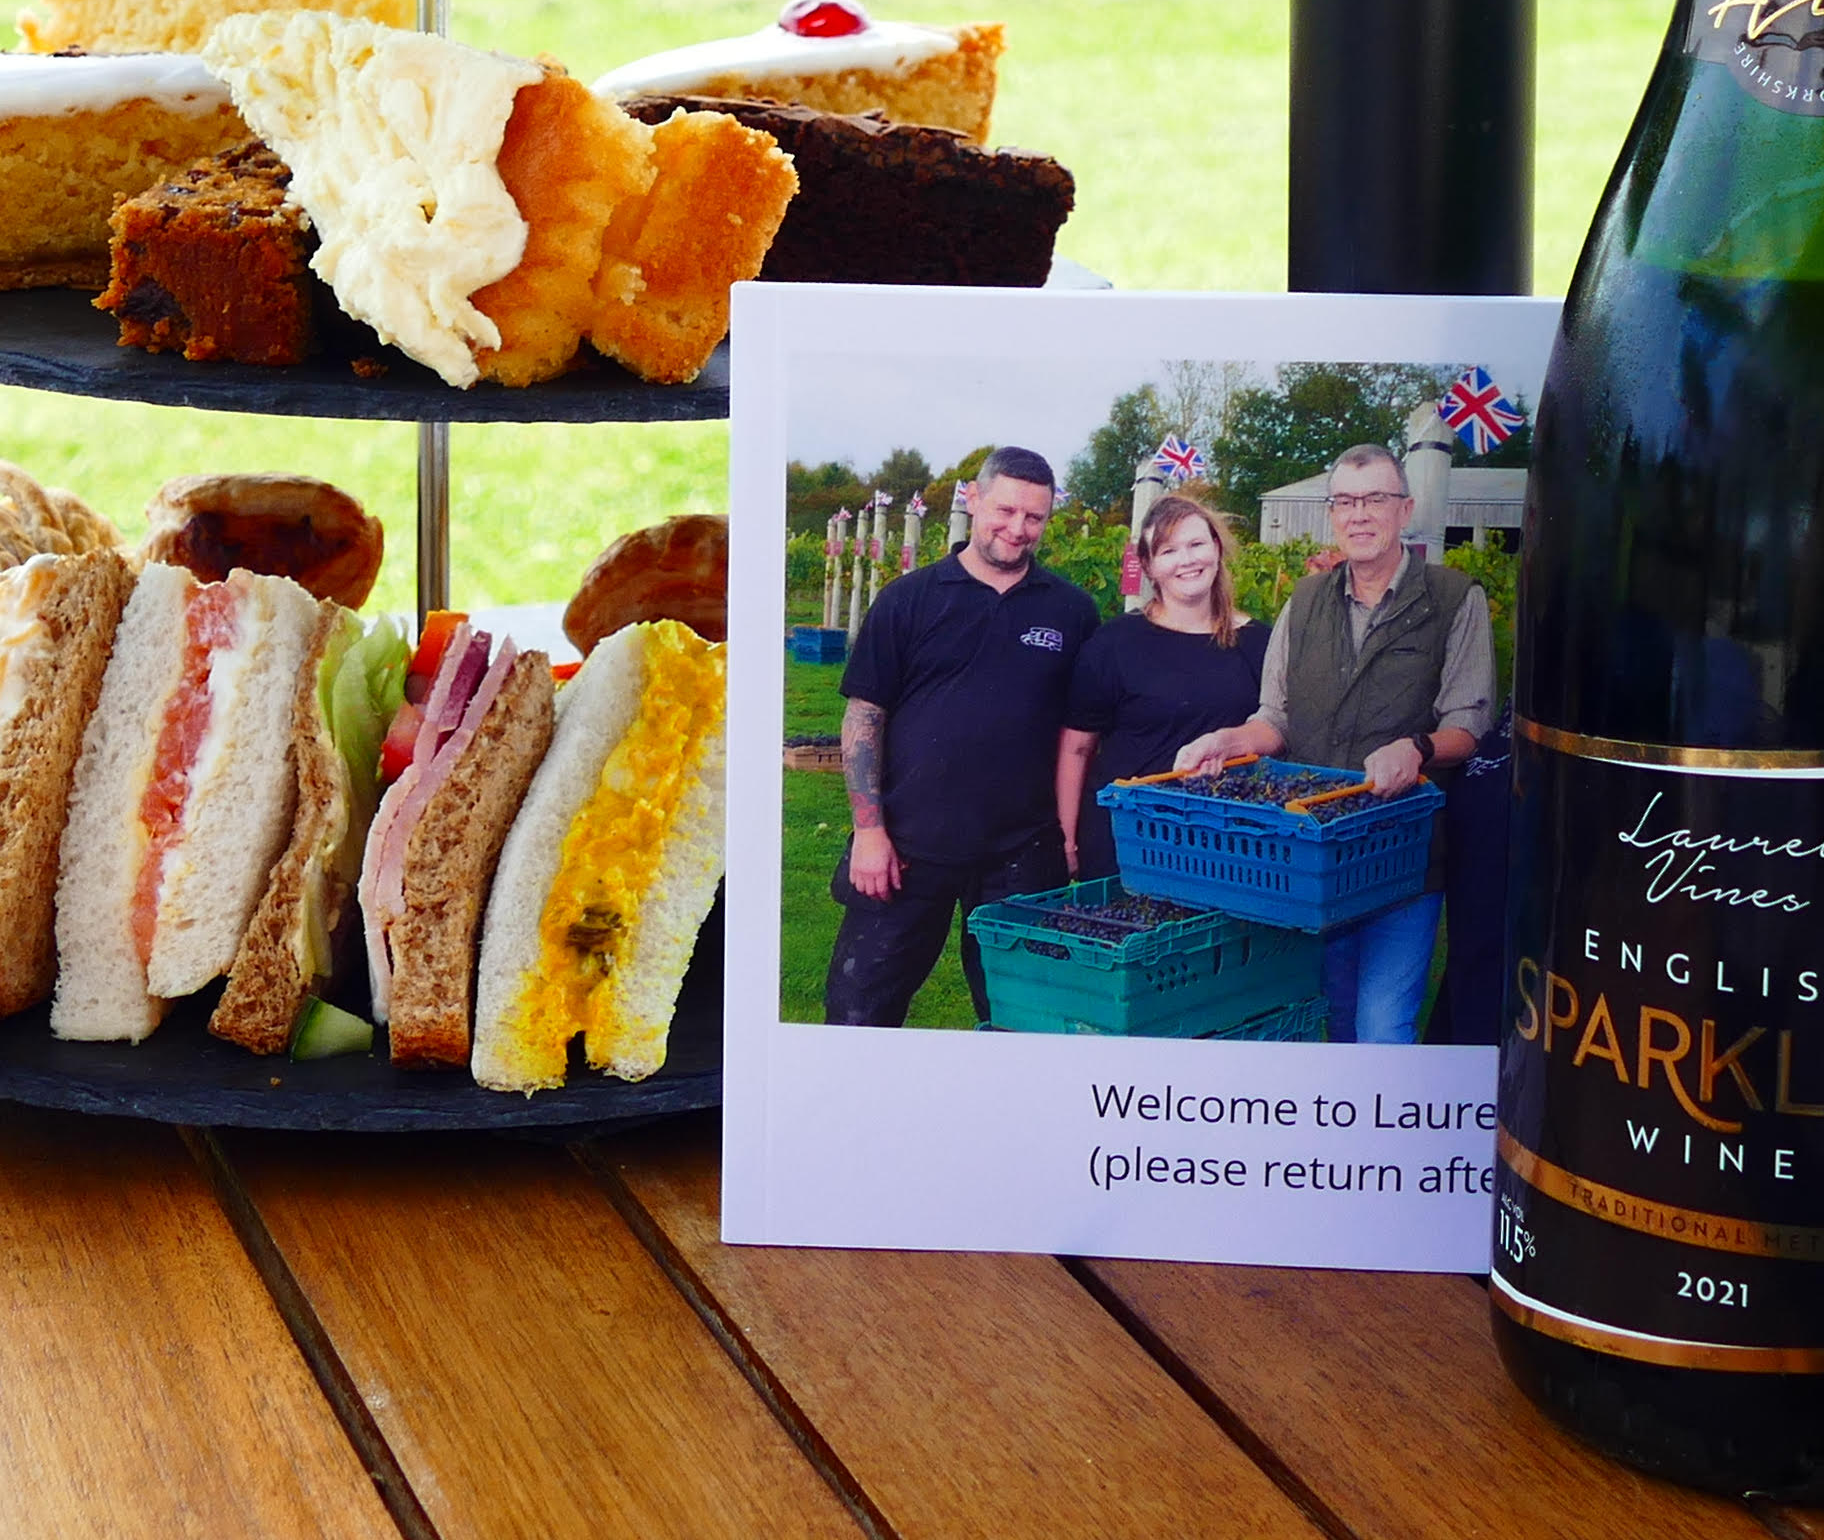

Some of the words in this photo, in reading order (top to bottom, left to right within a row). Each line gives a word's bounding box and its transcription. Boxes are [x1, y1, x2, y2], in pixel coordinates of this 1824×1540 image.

[1644, 848, 1811, 913] Vines
[1091, 1083, 1298, 1126] Welcome
[1313, 1094, 1358, 1128] to
[1374, 1093, 1496, 1130] Laure
[1089, 1146, 1247, 1191] (please
[1263, 1156, 1403, 1192] return
[1418, 1156, 1494, 1194] afte
[1626, 1119, 1796, 1181] WINE
[1499, 1208, 1537, 1264] 11.5%
[1569, 1181, 1746, 1247] TRADITIONAL
[1677, 1271, 1751, 1309] 2021
